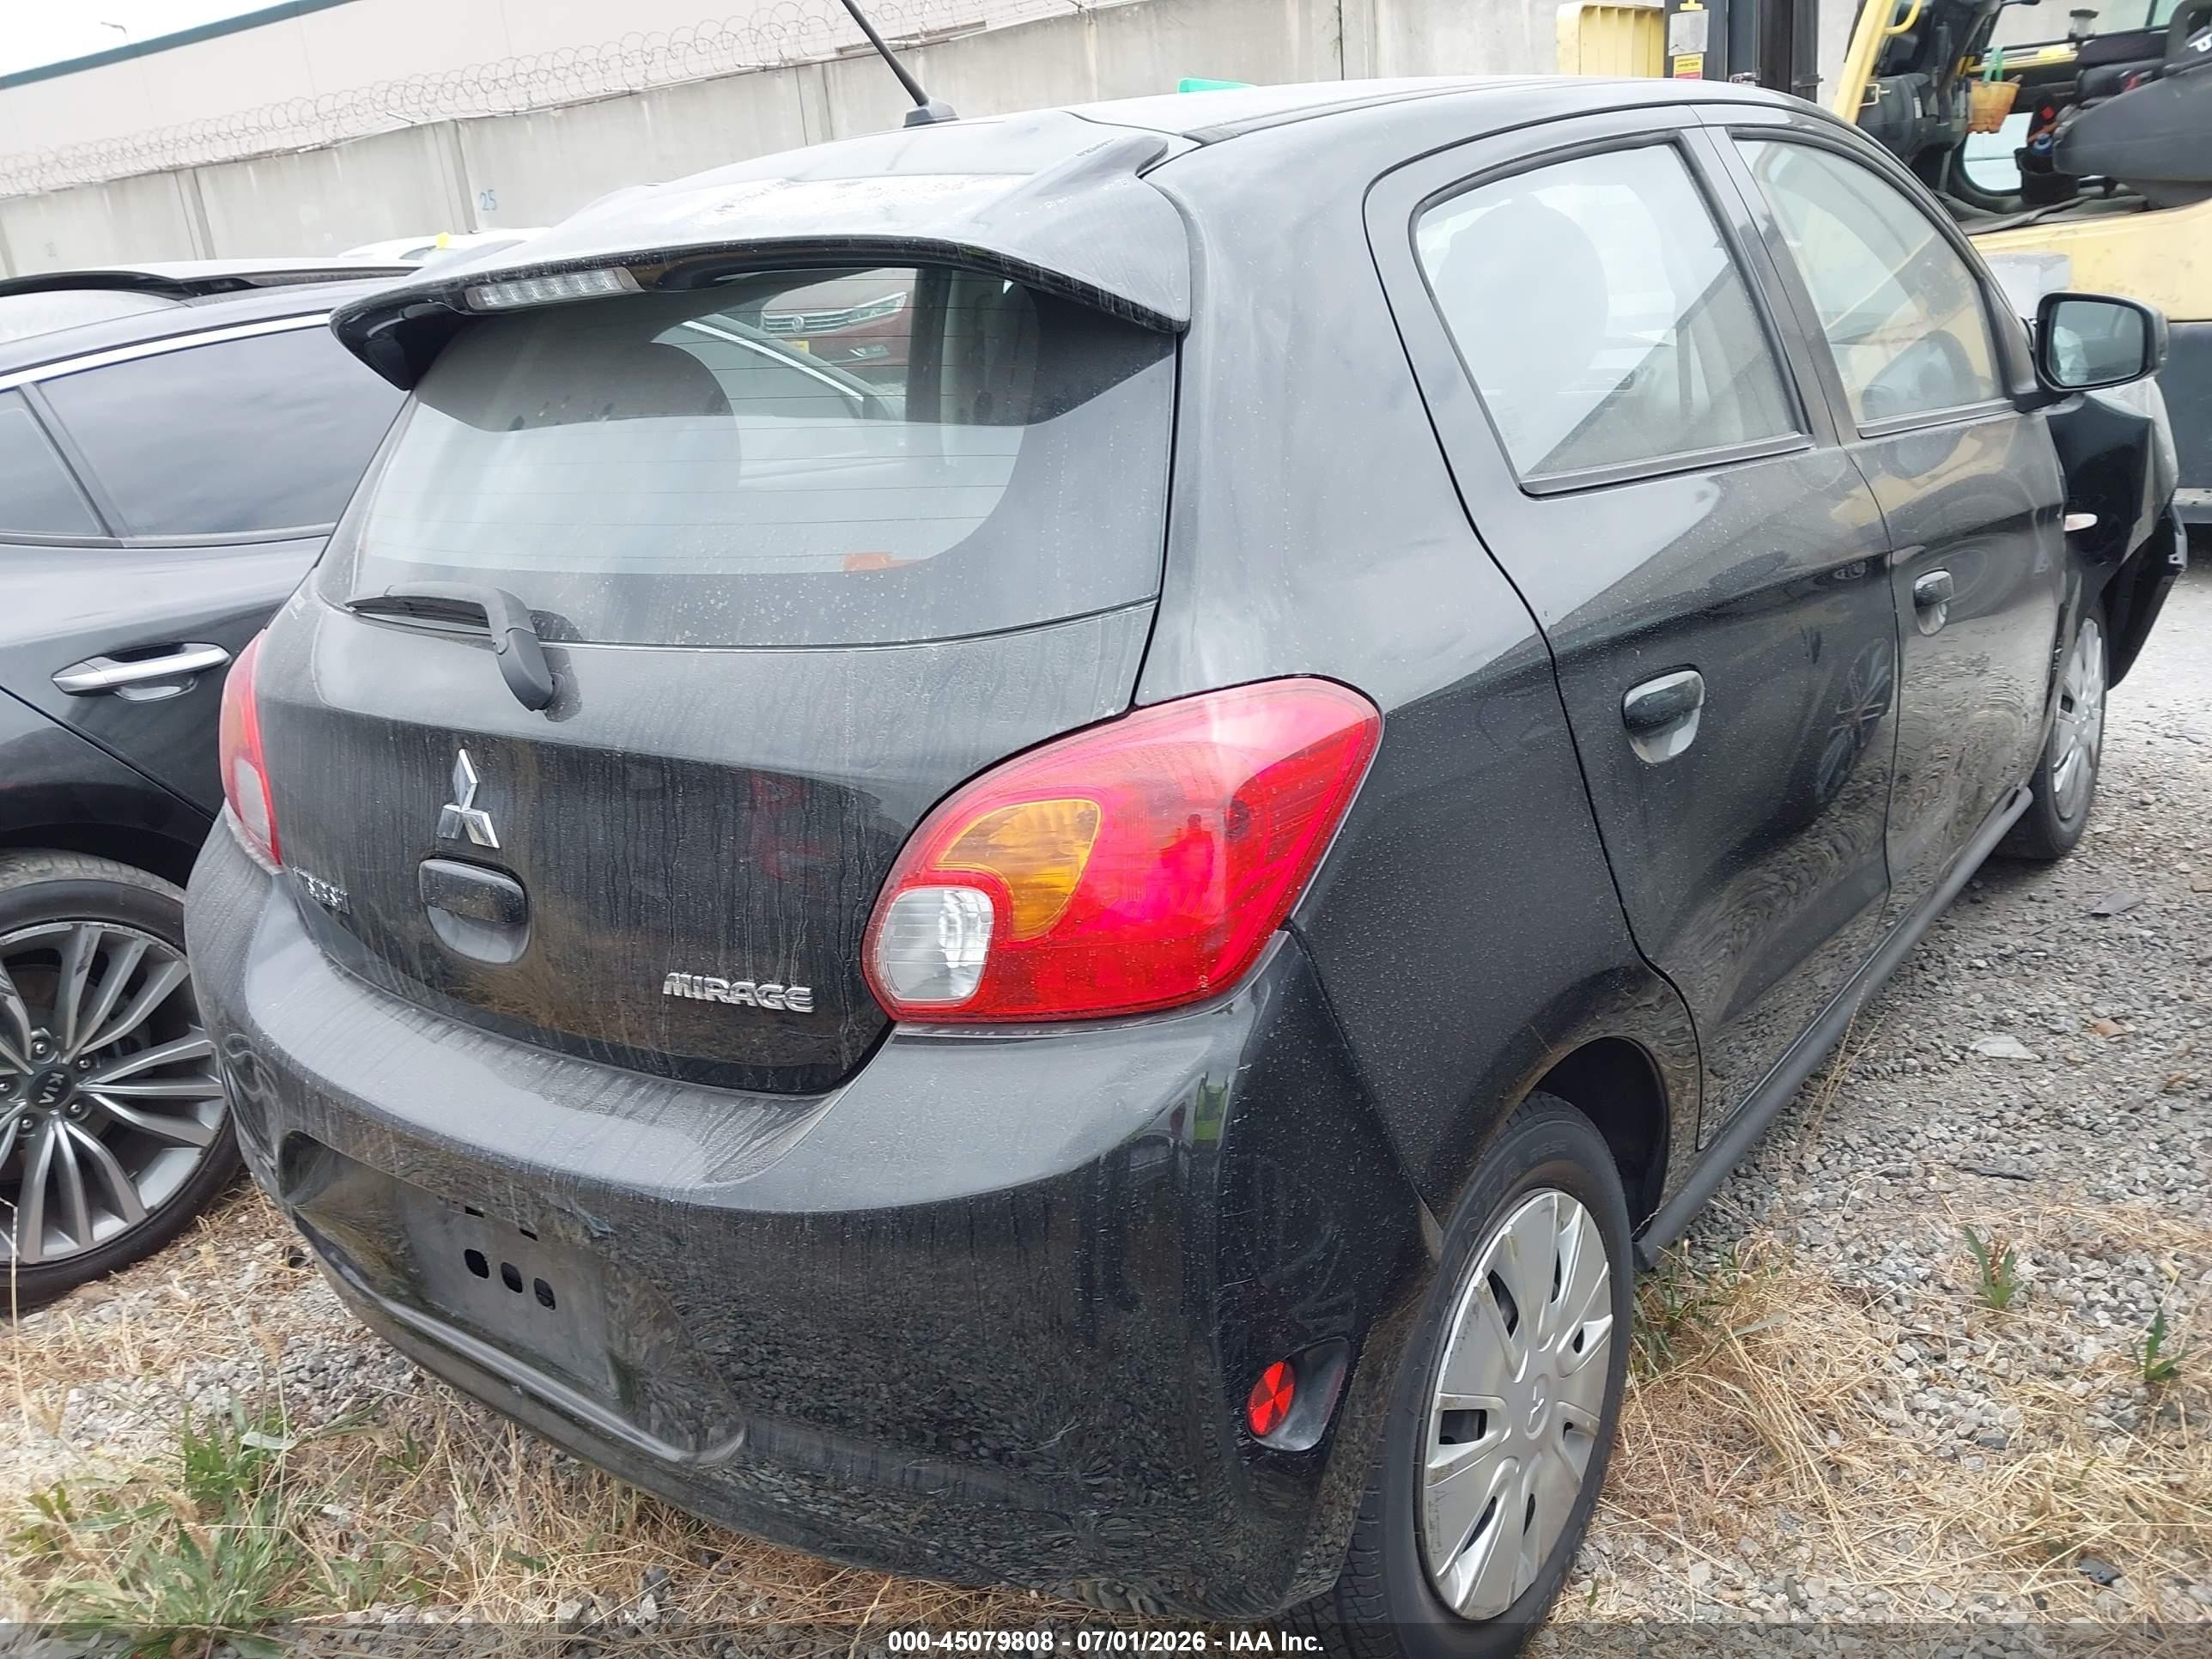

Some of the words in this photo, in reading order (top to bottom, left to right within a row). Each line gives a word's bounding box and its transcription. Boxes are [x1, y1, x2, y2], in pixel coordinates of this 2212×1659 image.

[480, 189, 497, 211] 25
[662, 972, 815, 1013] MIRAGE
[38, 1072, 65, 1104] KIA
